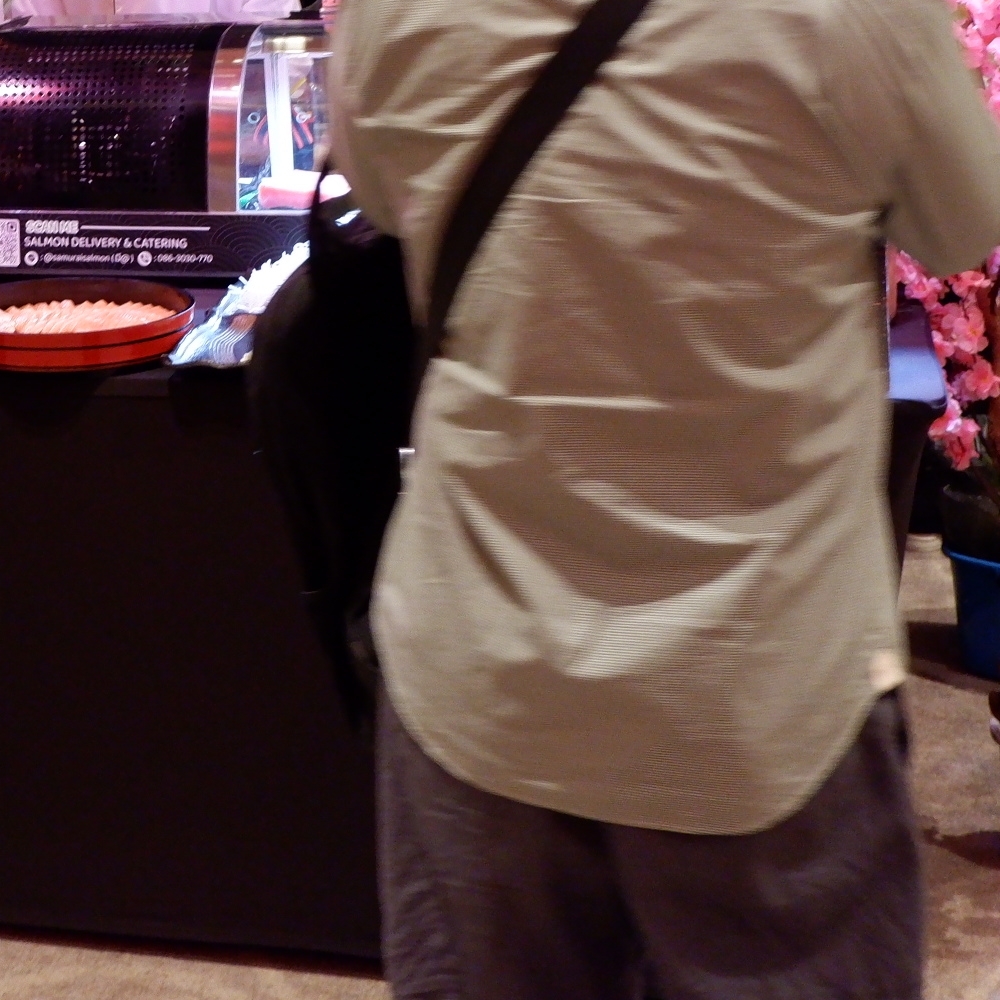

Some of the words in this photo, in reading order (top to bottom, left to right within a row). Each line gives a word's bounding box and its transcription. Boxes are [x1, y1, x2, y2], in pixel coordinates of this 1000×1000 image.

[25, 219, 59, 234] SCAN
[59, 220, 80, 235] ME
[24, 236, 69, 248] SALMON
[71, 236, 122, 248] DELIVERY
[123, 237, 132, 248] &
[133, 237, 188, 249] CATERING
